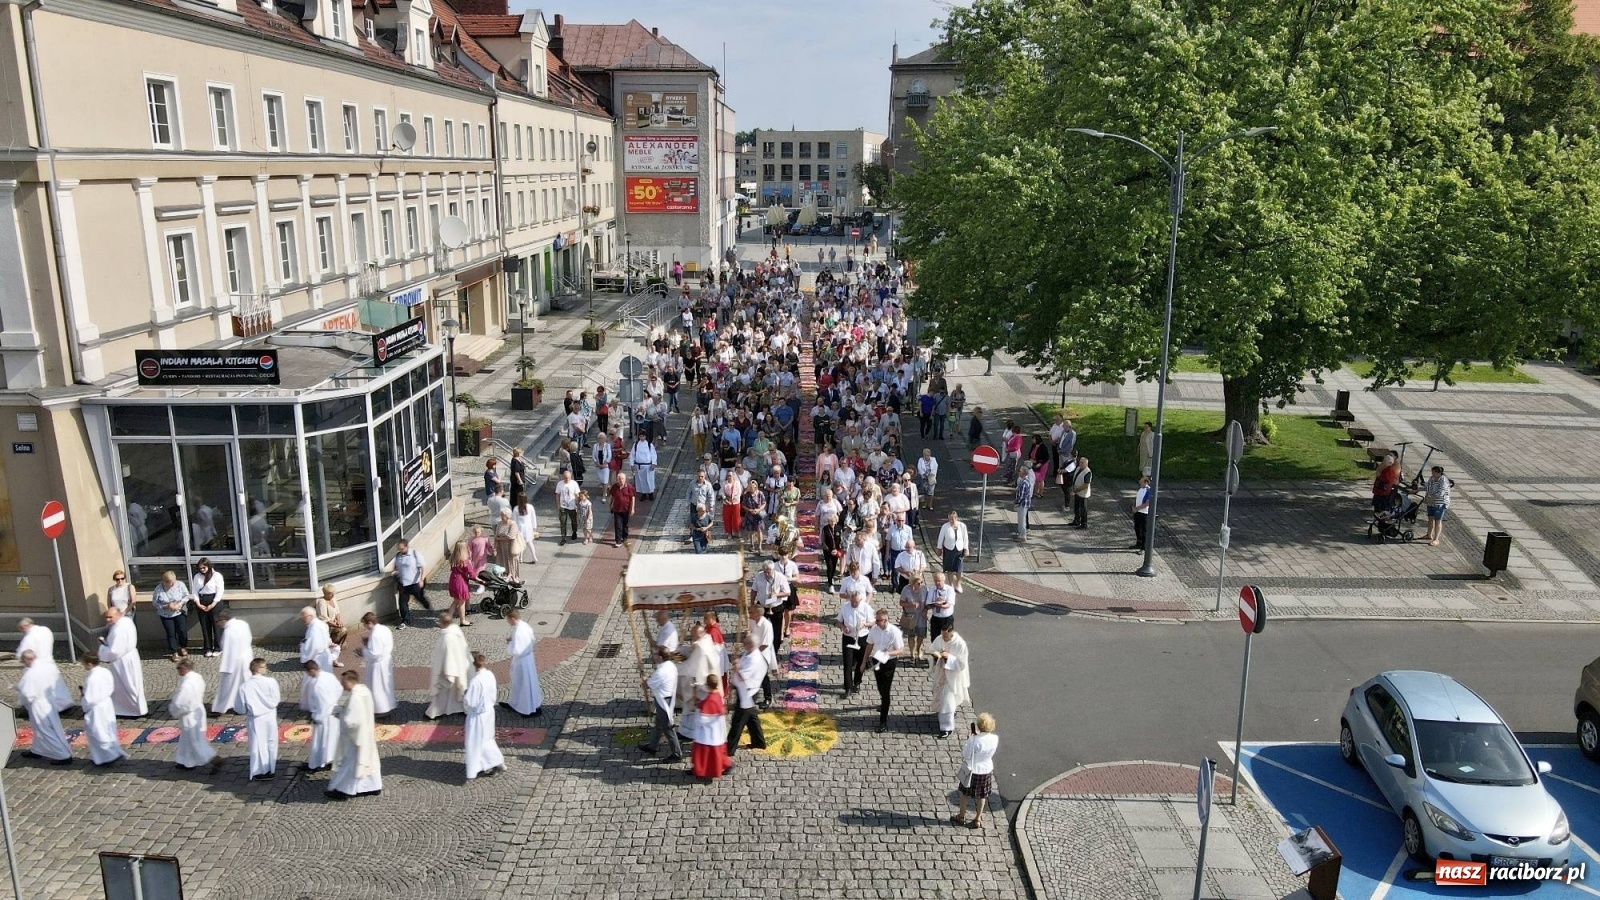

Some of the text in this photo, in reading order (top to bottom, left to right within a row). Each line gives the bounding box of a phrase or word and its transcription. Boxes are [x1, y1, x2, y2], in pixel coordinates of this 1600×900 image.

[322, 312, 356, 330] APTEKA
[160, 356, 258, 366] INDIAN MASALA KITCHEN
[1496, 857, 1514, 866] SRC
